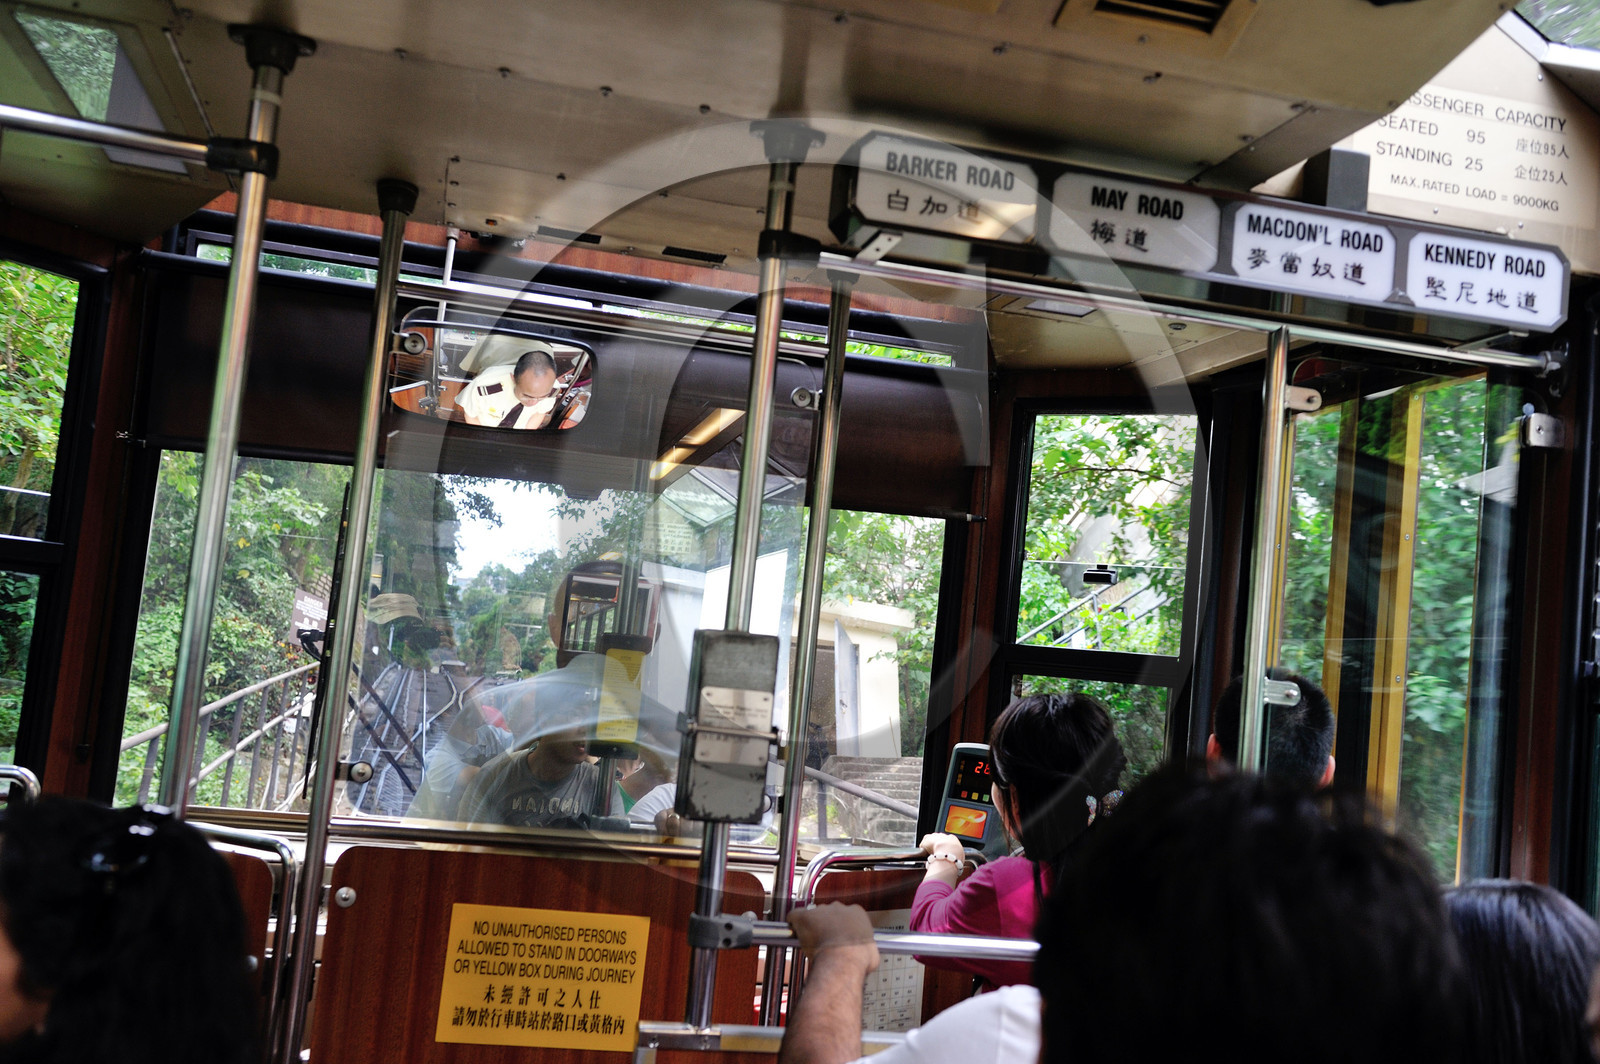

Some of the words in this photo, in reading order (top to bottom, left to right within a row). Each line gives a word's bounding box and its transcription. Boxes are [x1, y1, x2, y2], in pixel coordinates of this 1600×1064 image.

[1407, 91, 1484, 117] SSENGER
[1495, 107, 1567, 131] CAPACITY
[1377, 115, 1439, 137] SEATED
[1466, 129, 1486, 145] 95
[886, 151, 957, 182] BARKER
[966, 165, 1015, 192] ROAD
[1376, 141, 1453, 167] STANDING
[1464, 157, 1484, 172] 25
[887, 188, 982, 225] 白加道
[1091, 185, 1128, 210] MAY
[1138, 194, 1184, 221] ROAD
[1465, 186, 1497, 201] LOAD
[1513, 194, 1559, 212] 9000KG
[1091, 218, 1149, 252] 梅道
[1247, 214, 1332, 246] MACDON'L
[1340, 231, 1383, 253] ROAD
[1247, 247, 1367, 286] 麥當奴道
[1425, 243, 1496, 271] KENNEDY
[1504, 256, 1546, 279] ROAD
[1425, 276, 1539, 314] 堅尼地道
[473, 921, 490, 936] NO
[491, 922, 575, 942] UNAUTHORISED
[577, 928, 627, 945] PERSONS
[457, 939, 509, 957] ALLOWED
[512, 943, 526, 957] TO
[528, 943, 562, 961] STAND
[564, 947, 576, 961] IN
[578, 947, 637, 966] DOORWAYS
[453, 959, 470, 974] OR
[473, 960, 517, 977] YELLOW
[519, 962, 542, 979] BOX
[543, 965, 584, 982] DURING
[586, 967, 636, 985] JOURNEY
